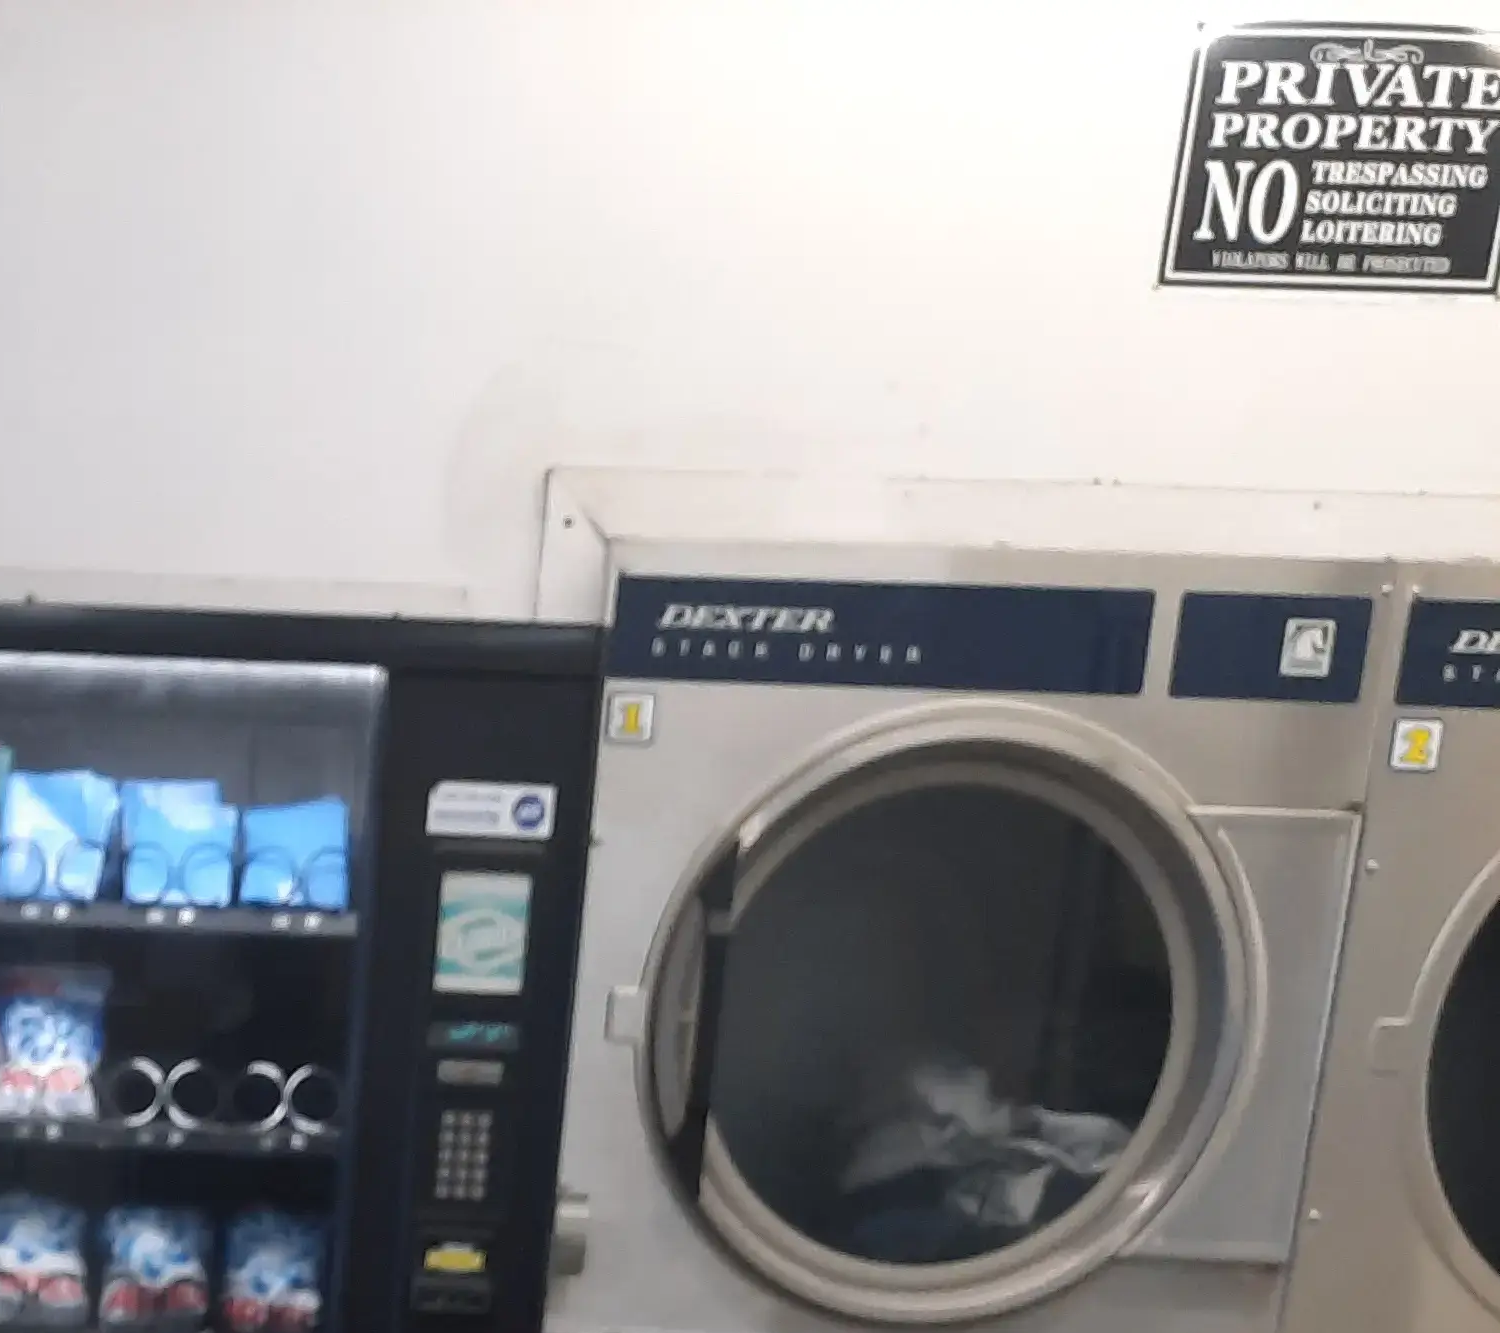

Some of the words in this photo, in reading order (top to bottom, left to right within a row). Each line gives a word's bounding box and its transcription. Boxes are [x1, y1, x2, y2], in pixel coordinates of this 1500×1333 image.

[1214, 60, 1500, 110] PRIVATE
[1207, 112, 1500, 154] PROPERTY
[1311, 160, 1489, 188] TRESPASSING
[1192, 159, 1300, 244] NO
[1304, 189, 1458, 217] SOLICITING
[1299, 219, 1443, 247] LOITERING
[657, 604, 835, 632] DEXTER
[621, 701, 641, 734] 1
[1400, 728, 1430, 763] 2
